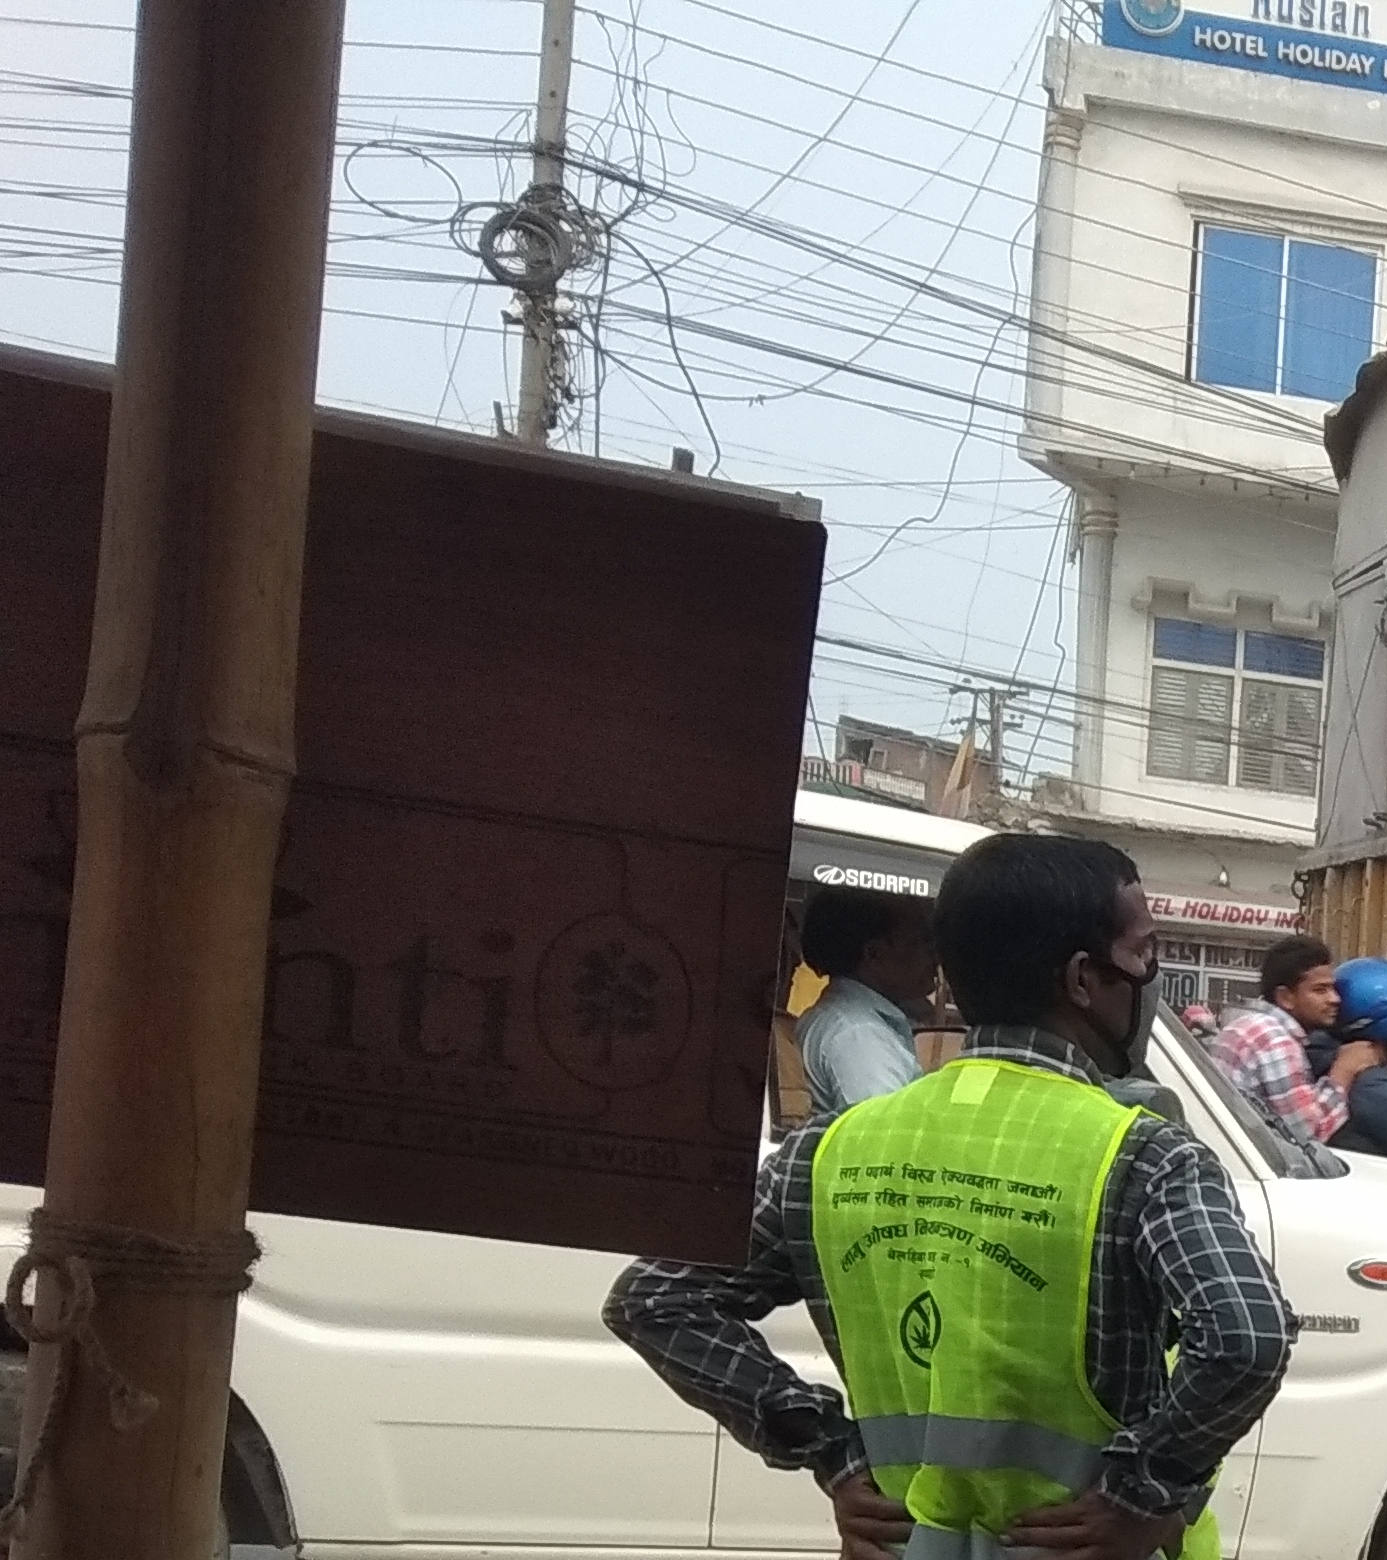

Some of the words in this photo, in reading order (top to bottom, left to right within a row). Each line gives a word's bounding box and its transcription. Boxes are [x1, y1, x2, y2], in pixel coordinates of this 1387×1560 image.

[1193, 26, 1268, 58] HOTEL
[1277, 39, 1375, 75] HOLIDAY
[845, 868, 929, 897] SCORPIO
[1181, 900, 1270, 926] HOLIDAY
[875, 1190, 908, 1208] रहित
[974, 1237, 1050, 1293] अभियान
